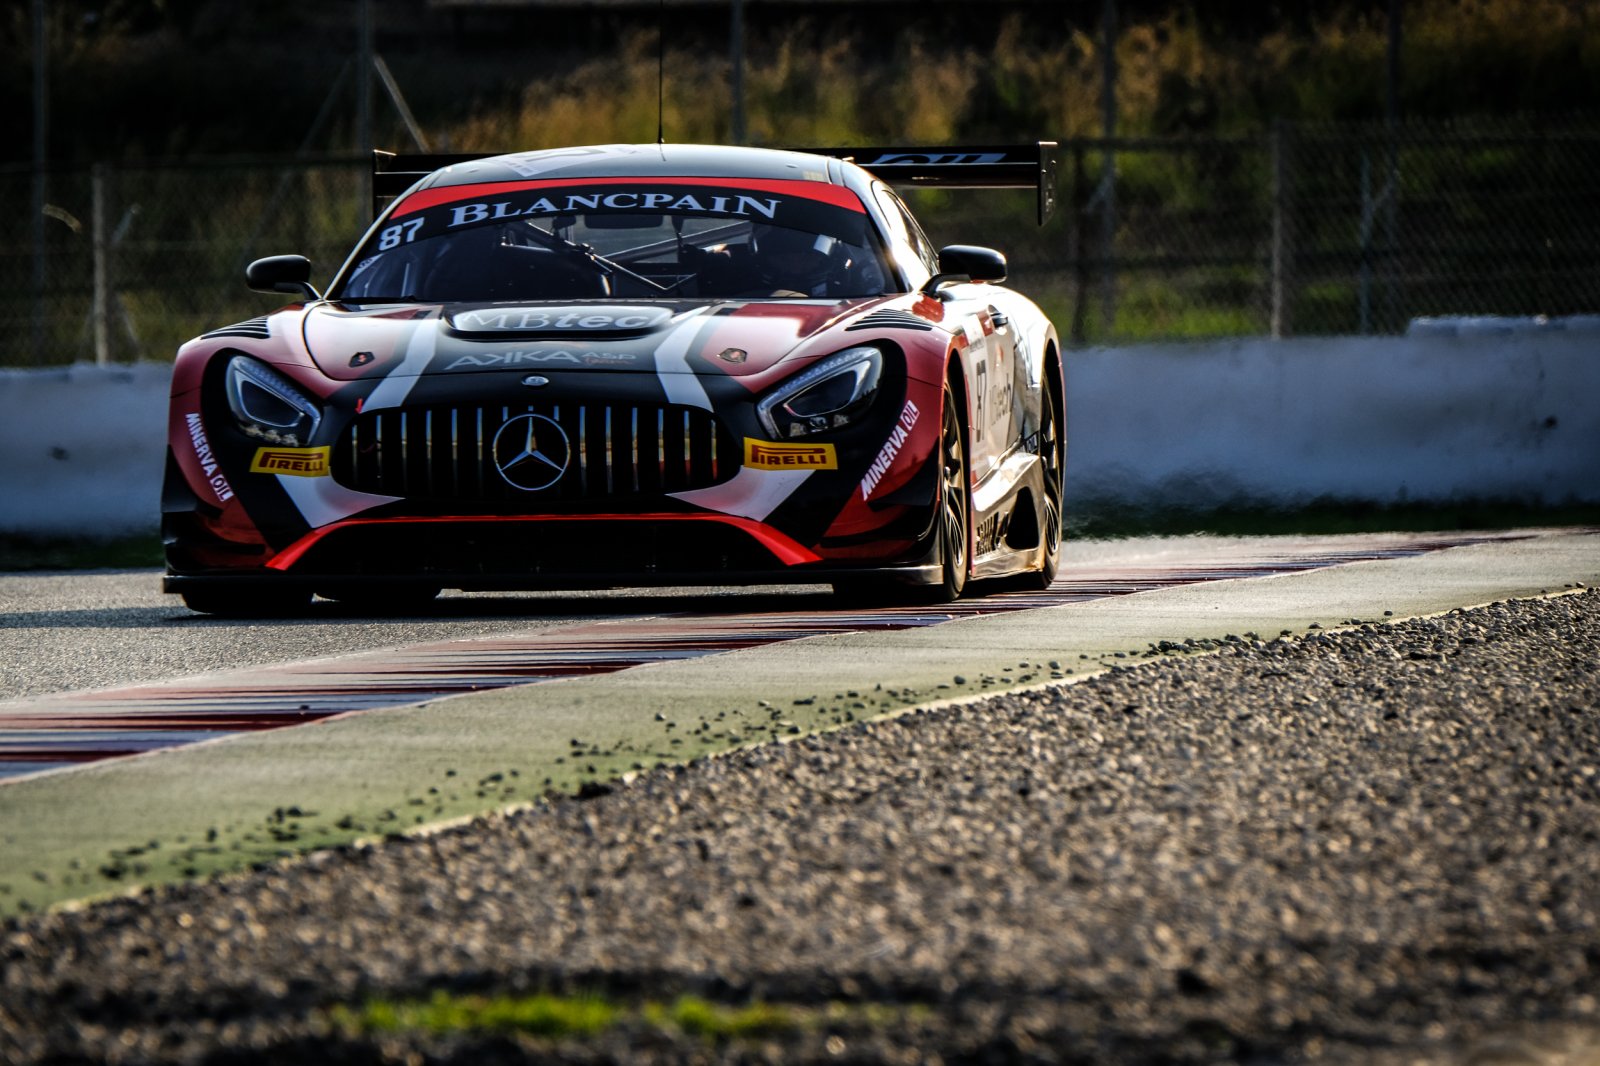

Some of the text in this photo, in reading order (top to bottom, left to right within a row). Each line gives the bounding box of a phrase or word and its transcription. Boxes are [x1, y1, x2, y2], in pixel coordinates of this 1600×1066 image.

[448, 193, 781, 228] BLANCPAIN
[379, 217, 425, 251] 87
[462, 311, 669, 329] MBtec
[444, 351, 581, 370] AKKA
[185, 413, 234, 501] MINERVA OIL
[259, 452, 323, 471] PIRELLI
[752, 444, 827, 465] PIRELLI
[859, 401, 920, 501] MINERVA OIL
